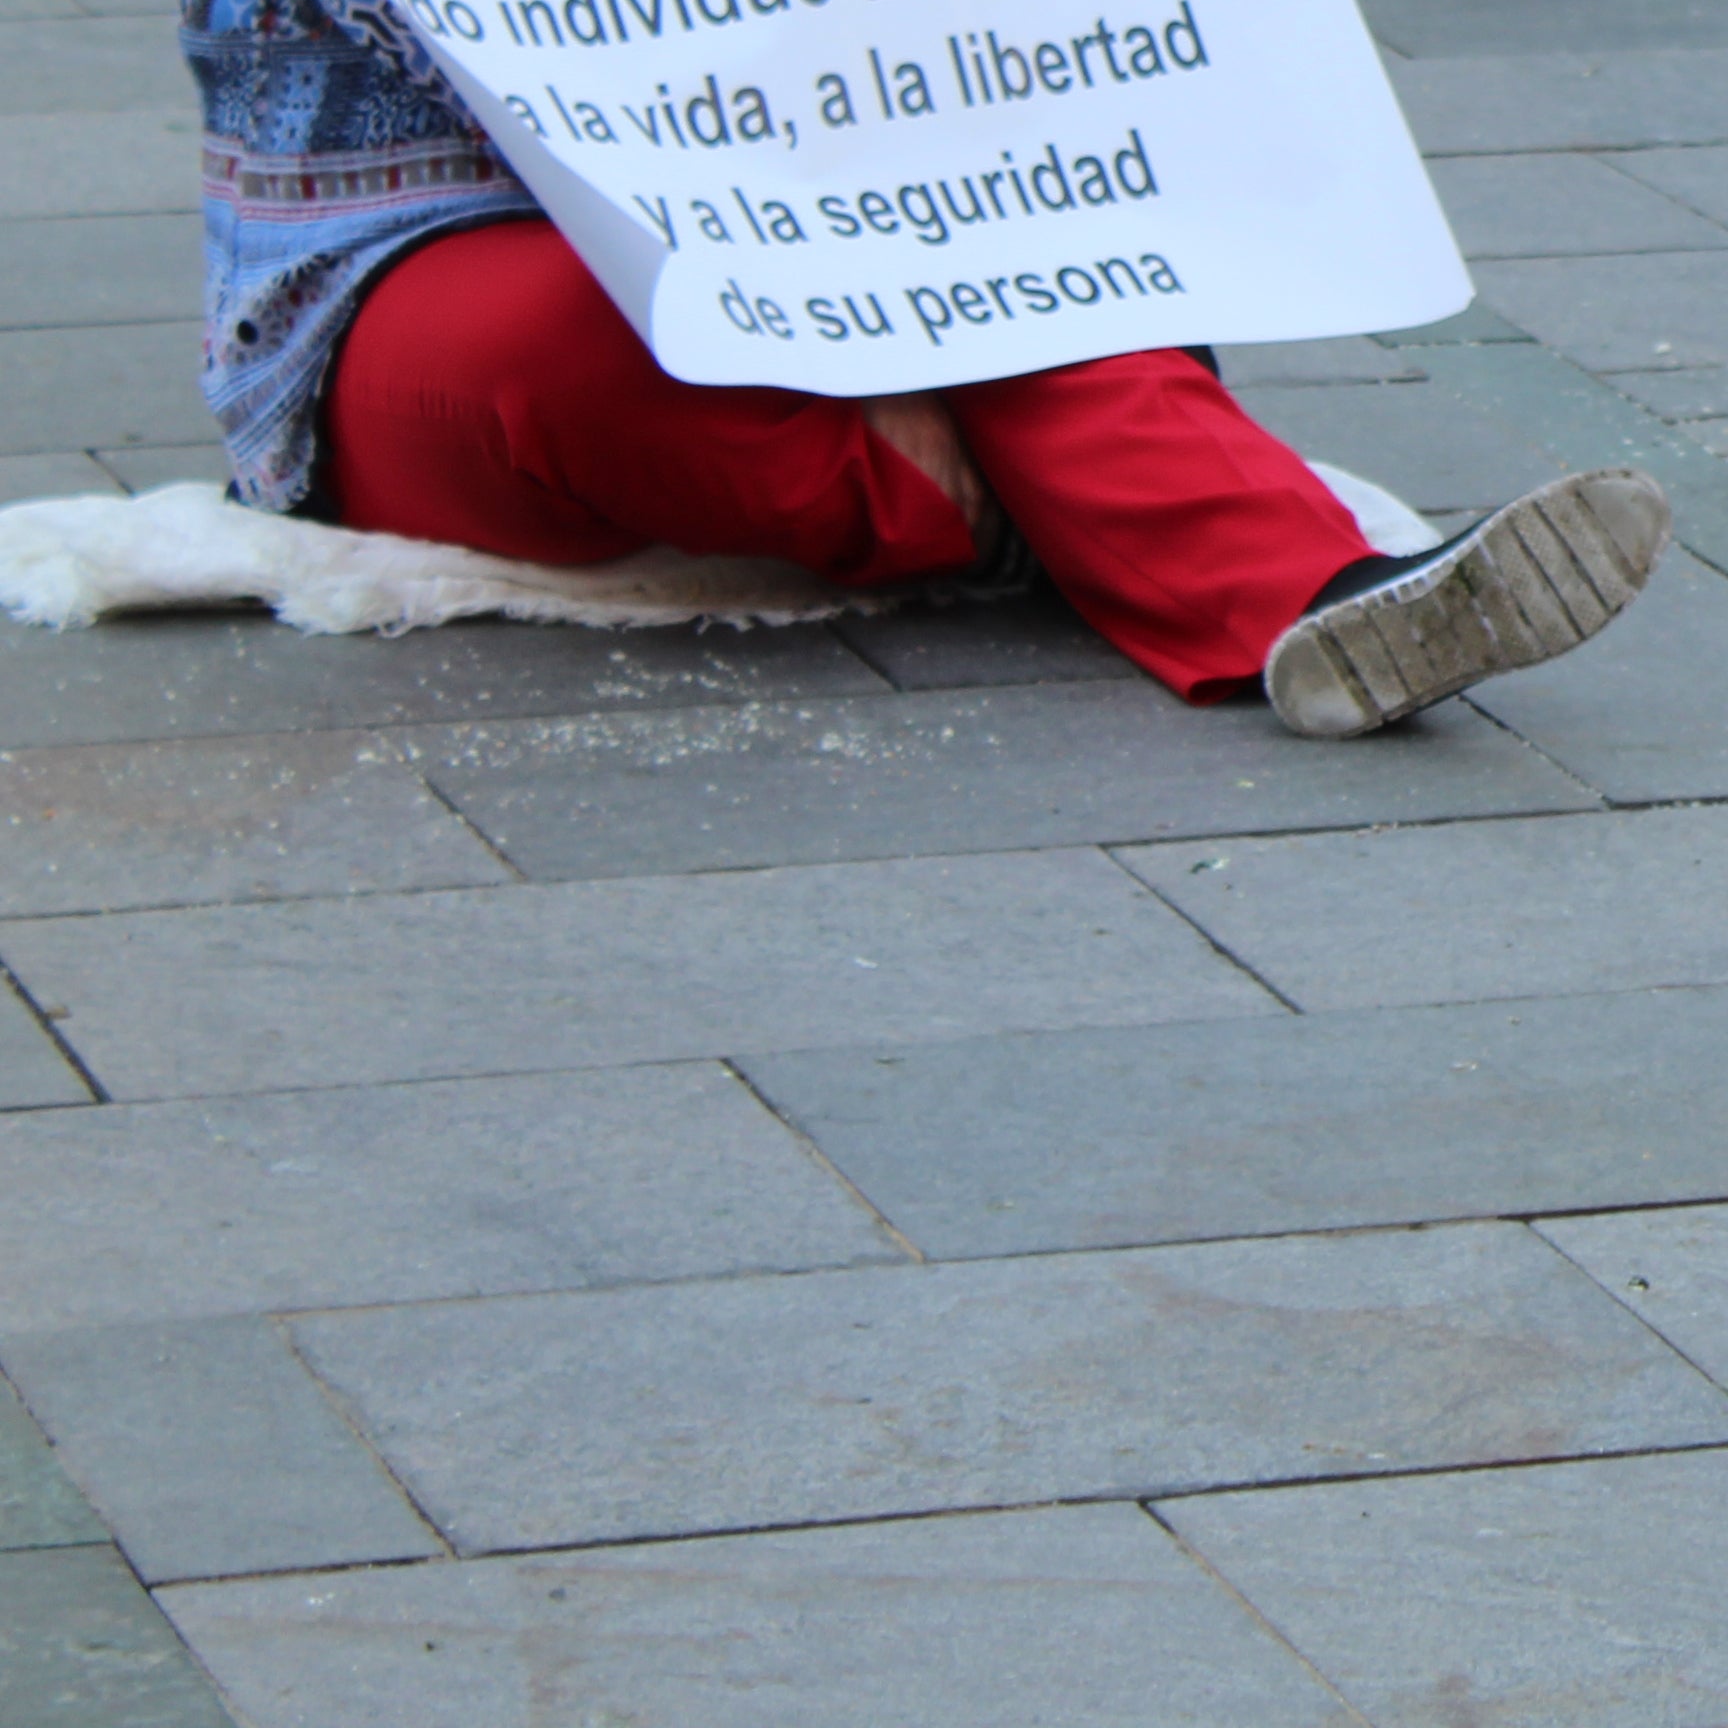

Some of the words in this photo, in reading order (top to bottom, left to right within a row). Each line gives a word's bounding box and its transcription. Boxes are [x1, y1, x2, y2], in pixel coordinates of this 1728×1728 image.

[505, 93, 549, 139] a
[544, 84, 620, 144] la
[621, 73, 798, 150] vida,
[816, 72, 858, 129] a
[867, 47, 936, 120] la
[953, 0, 1211, 108] libertad
[633, 194, 679, 252] y
[689, 198, 734, 244] a
[728, 186, 810, 245] la
[816, 127, 1160, 247] seguridad
[719, 278, 795, 340] de
[804, 292, 895, 342] su
[907, 253, 1187, 347] persona
